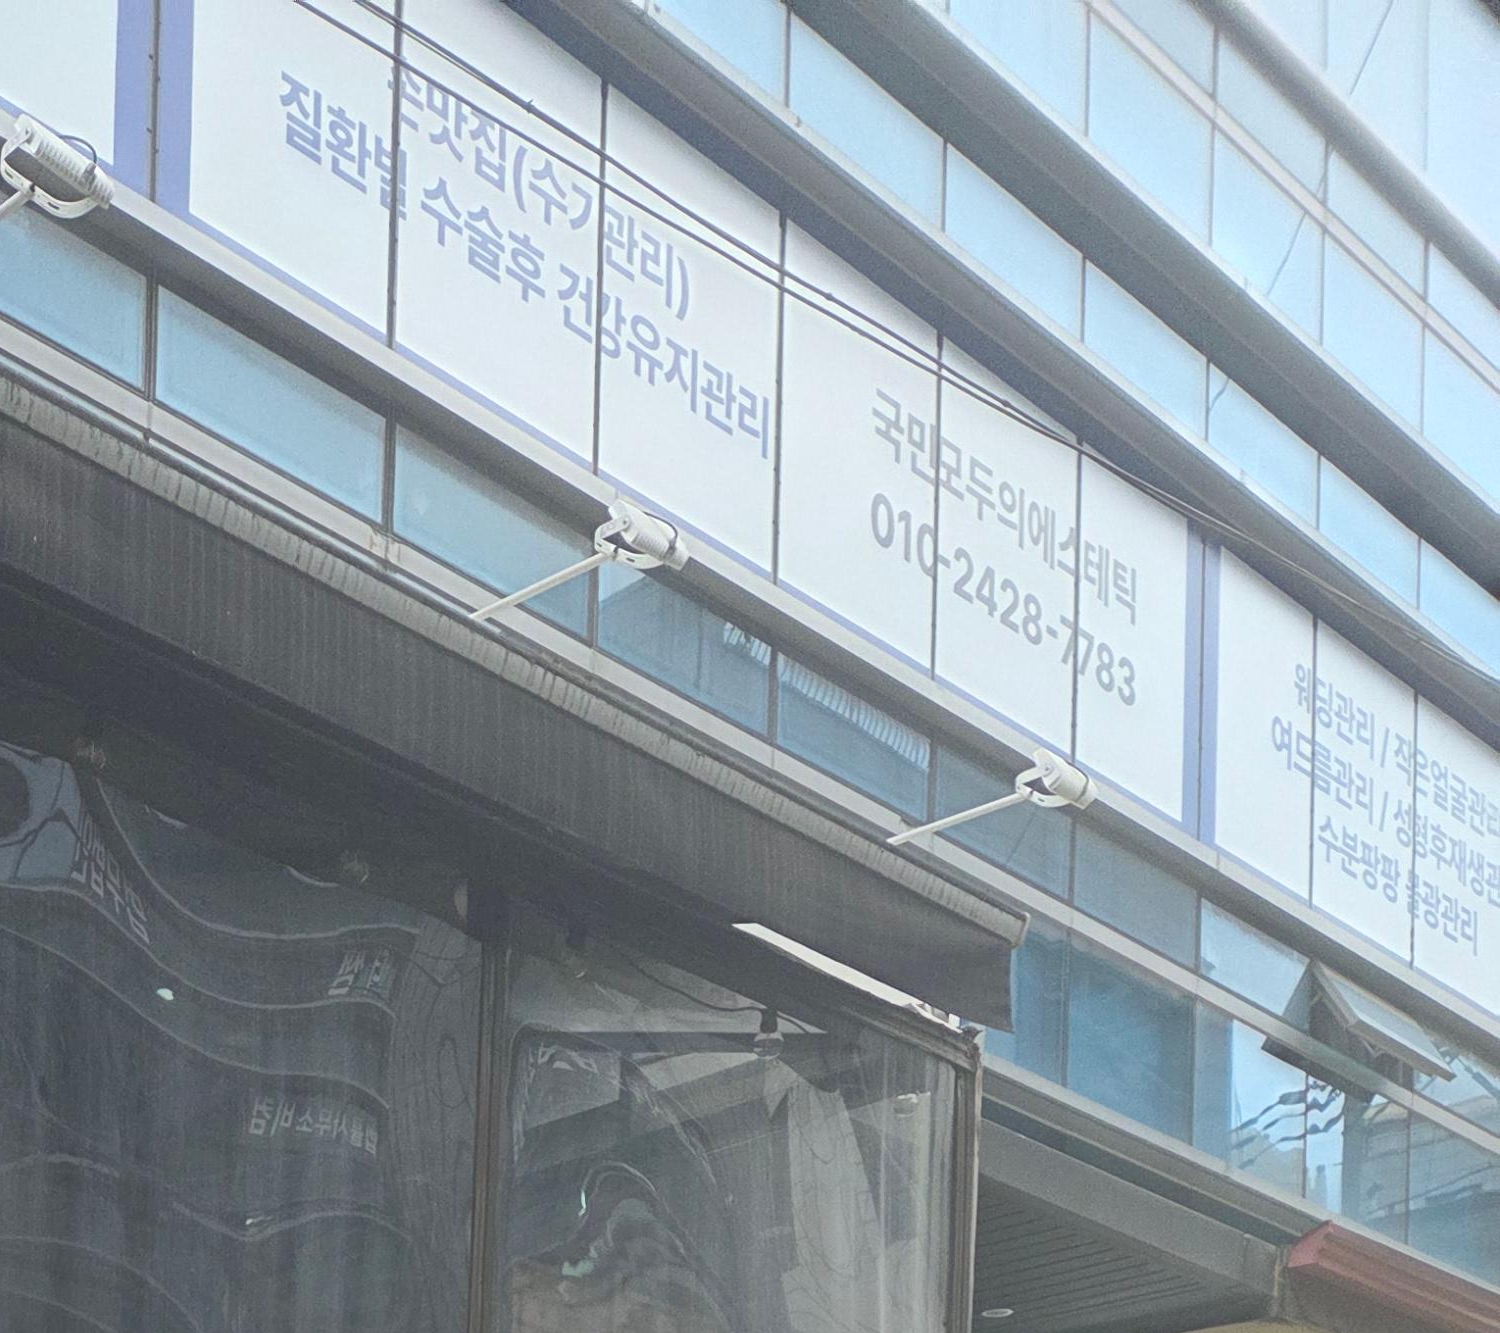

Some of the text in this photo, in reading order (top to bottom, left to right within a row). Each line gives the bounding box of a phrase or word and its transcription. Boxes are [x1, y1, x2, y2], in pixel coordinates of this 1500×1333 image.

[280, 70, 770, 460] 질환별 수술후 건강유지관리
[870, 492, 1137, 707] 010-2428-7783
[871, 387, 1137, 627] 국민모두의에스테틱
[1271, 715, 1375, 826] 여드름관리
[1317, 814, 1401, 904] 수분팡팡
